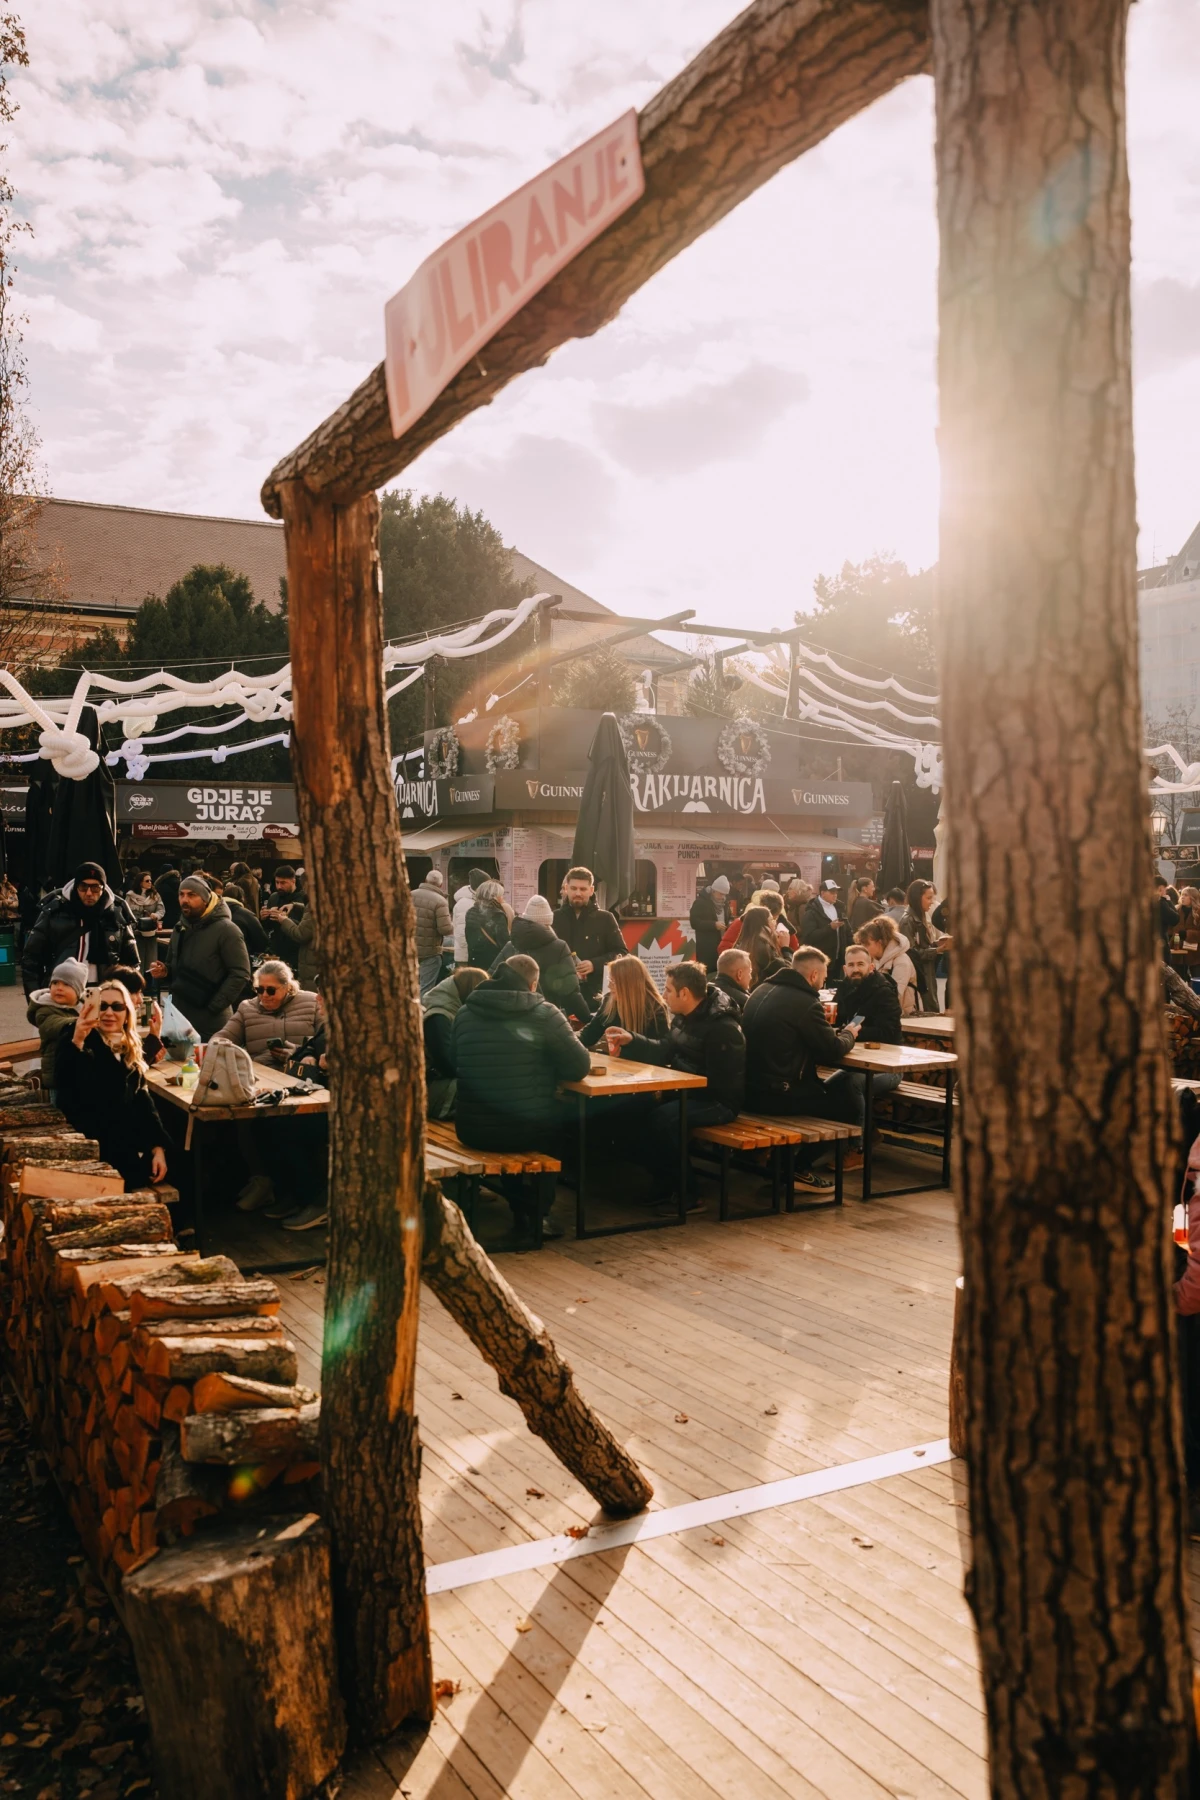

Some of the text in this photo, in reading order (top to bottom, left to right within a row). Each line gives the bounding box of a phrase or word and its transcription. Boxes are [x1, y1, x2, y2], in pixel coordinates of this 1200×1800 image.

[187, 788, 272, 806] GDJE JE
[455, 790, 481, 803] GUINNESS
[540, 783, 584, 798] GUINNE
[630, 773, 767, 814] RAKIJARNICA
[394, 780, 439, 817] KIJARNICA
[803, 792, 850, 806] GUINNESS
[196, 805, 265, 821] JURA?
[677, 850, 700, 859] PUNCH
